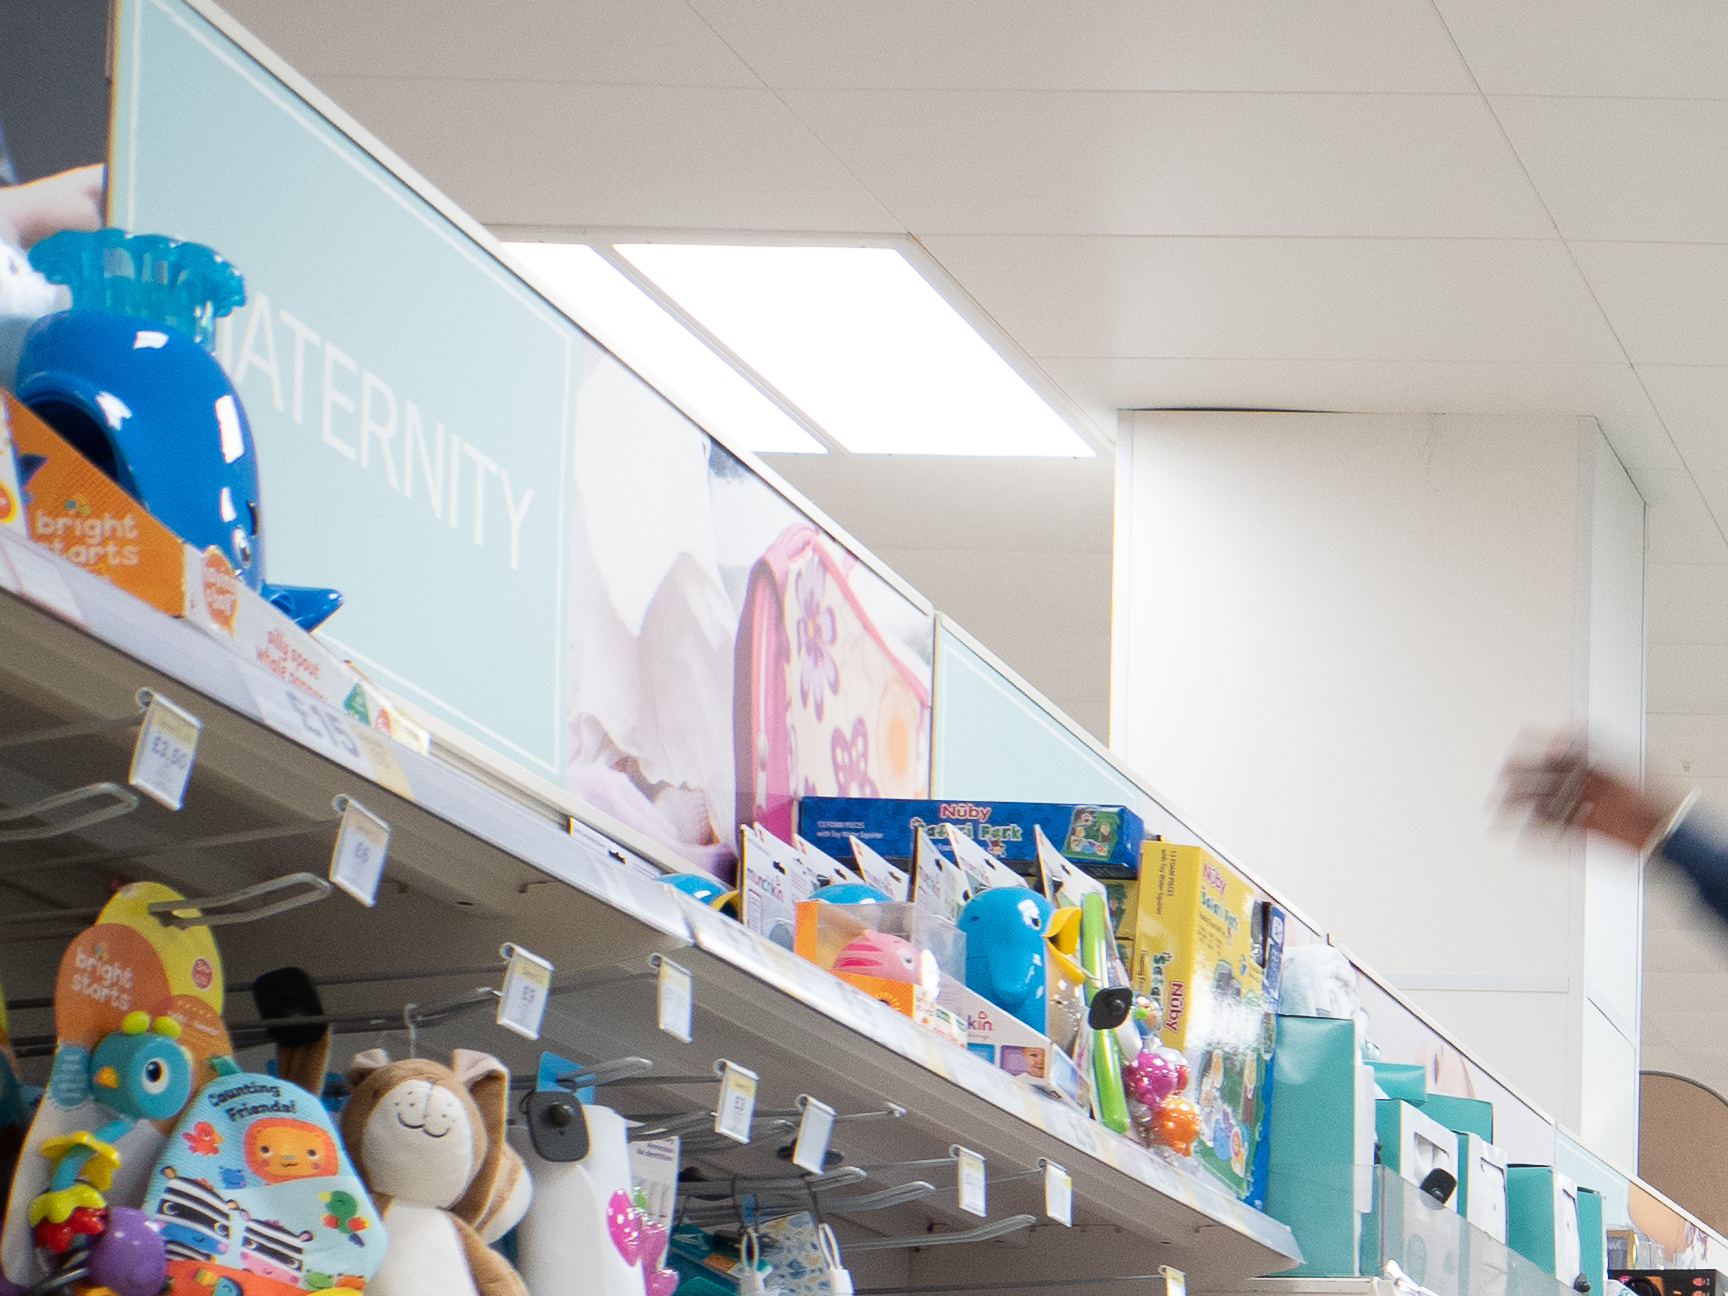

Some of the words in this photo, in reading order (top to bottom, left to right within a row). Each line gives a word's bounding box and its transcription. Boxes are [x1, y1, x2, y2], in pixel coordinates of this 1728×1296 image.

[36, 510, 139, 542] bright
[75, 946, 134, 993] bright
[71, 971, 132, 1012] starts
[207, 1081, 283, 1108] Counting
[226, 1097, 298, 1121] Friends!
